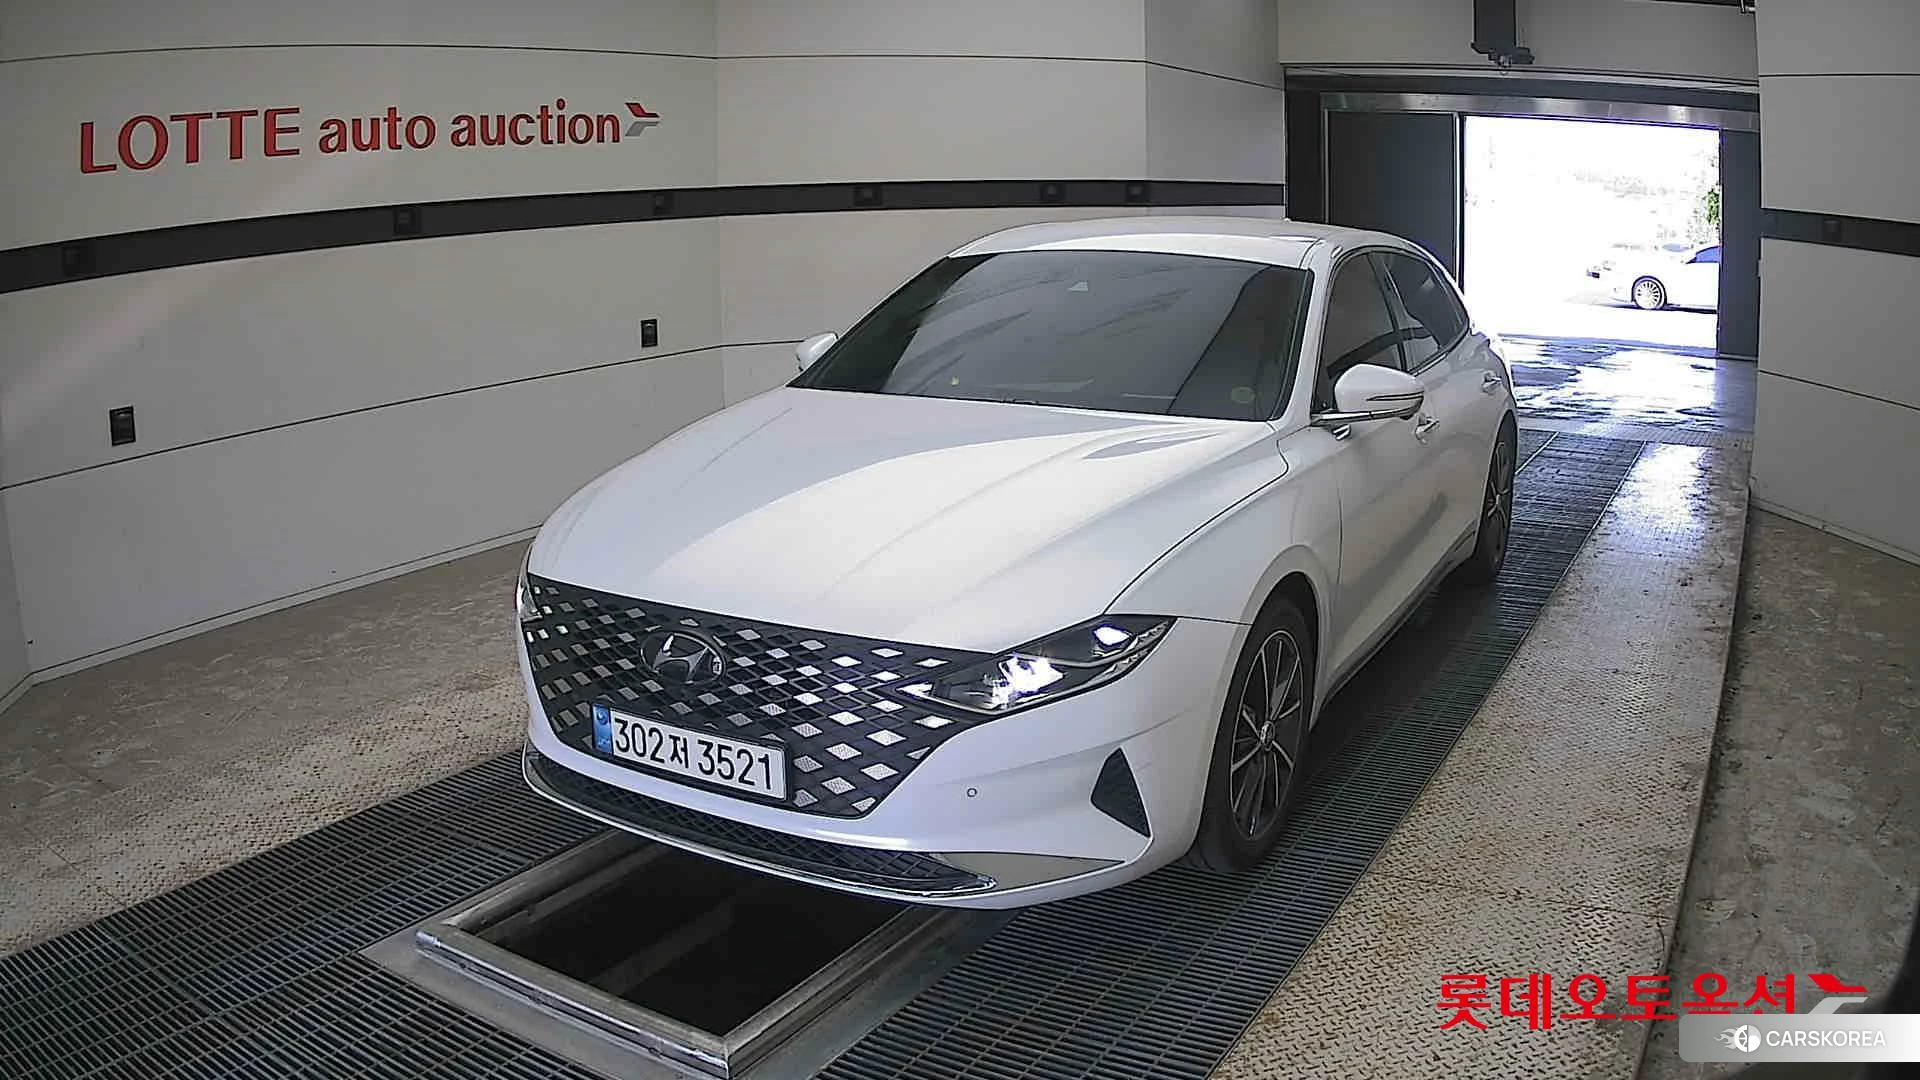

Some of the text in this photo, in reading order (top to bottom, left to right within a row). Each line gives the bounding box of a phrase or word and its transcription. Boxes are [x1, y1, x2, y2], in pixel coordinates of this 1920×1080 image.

[80, 98, 621, 174] LOTTE auto auction
[614, 718, 771, 790] 302저 3521
